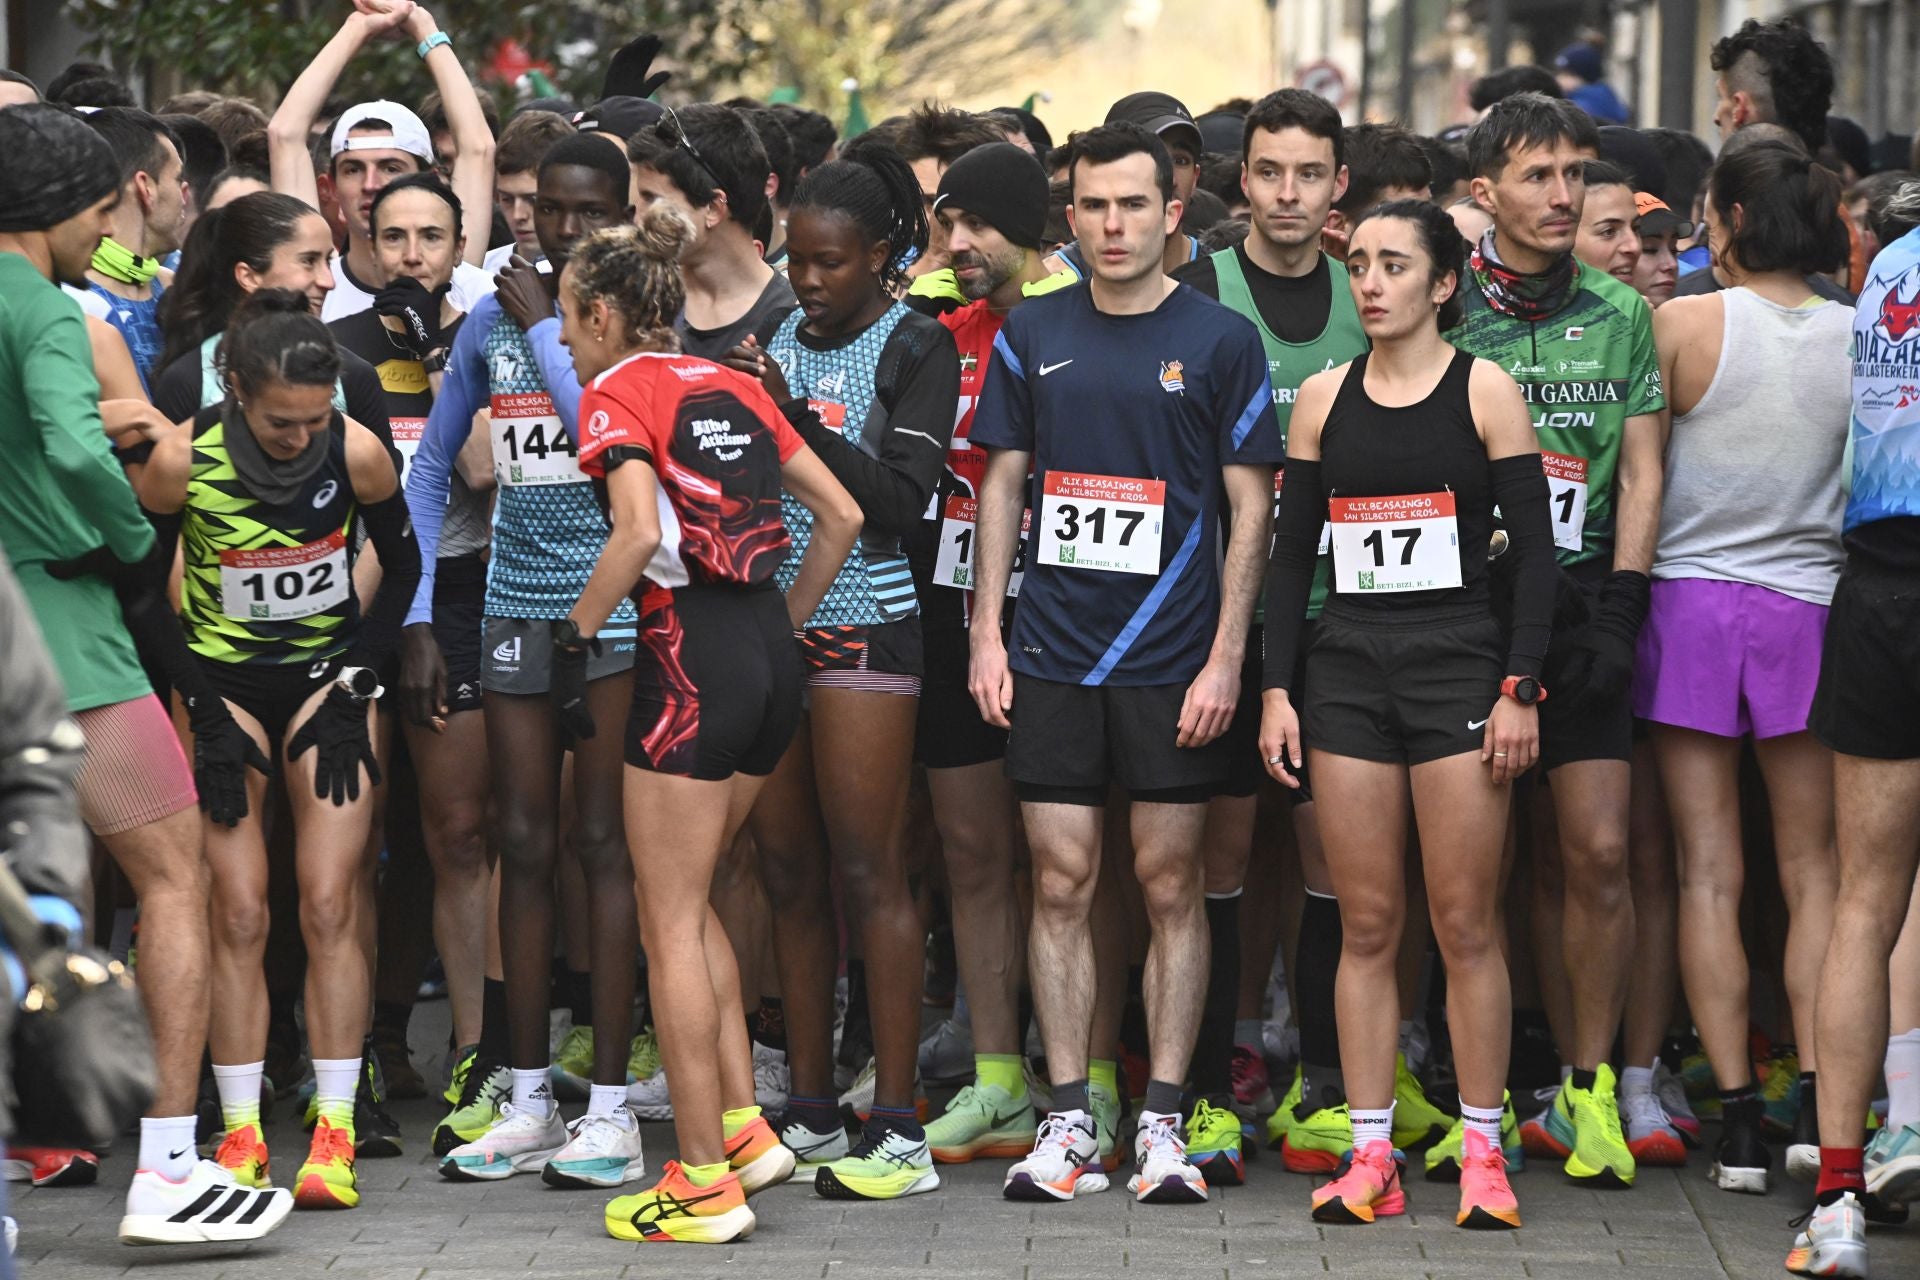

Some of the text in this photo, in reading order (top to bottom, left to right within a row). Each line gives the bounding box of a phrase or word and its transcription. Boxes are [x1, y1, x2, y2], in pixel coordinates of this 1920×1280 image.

[1866, 364, 1919, 380] LASTERKETA
[1541, 382, 1619, 404] GARAIA
[503, 424, 577, 461] 144
[1056, 486, 1149, 502] SAN SILBESTRE KROSA
[1554, 488, 1576, 524] 1
[956, 510, 969, 519] SAN
[1055, 504, 1145, 547] 317
[1343, 508, 1440, 521] SAN SILBESTRE KROSA
[1363, 527, 1422, 567] 17
[241, 562, 334, 602] 102
